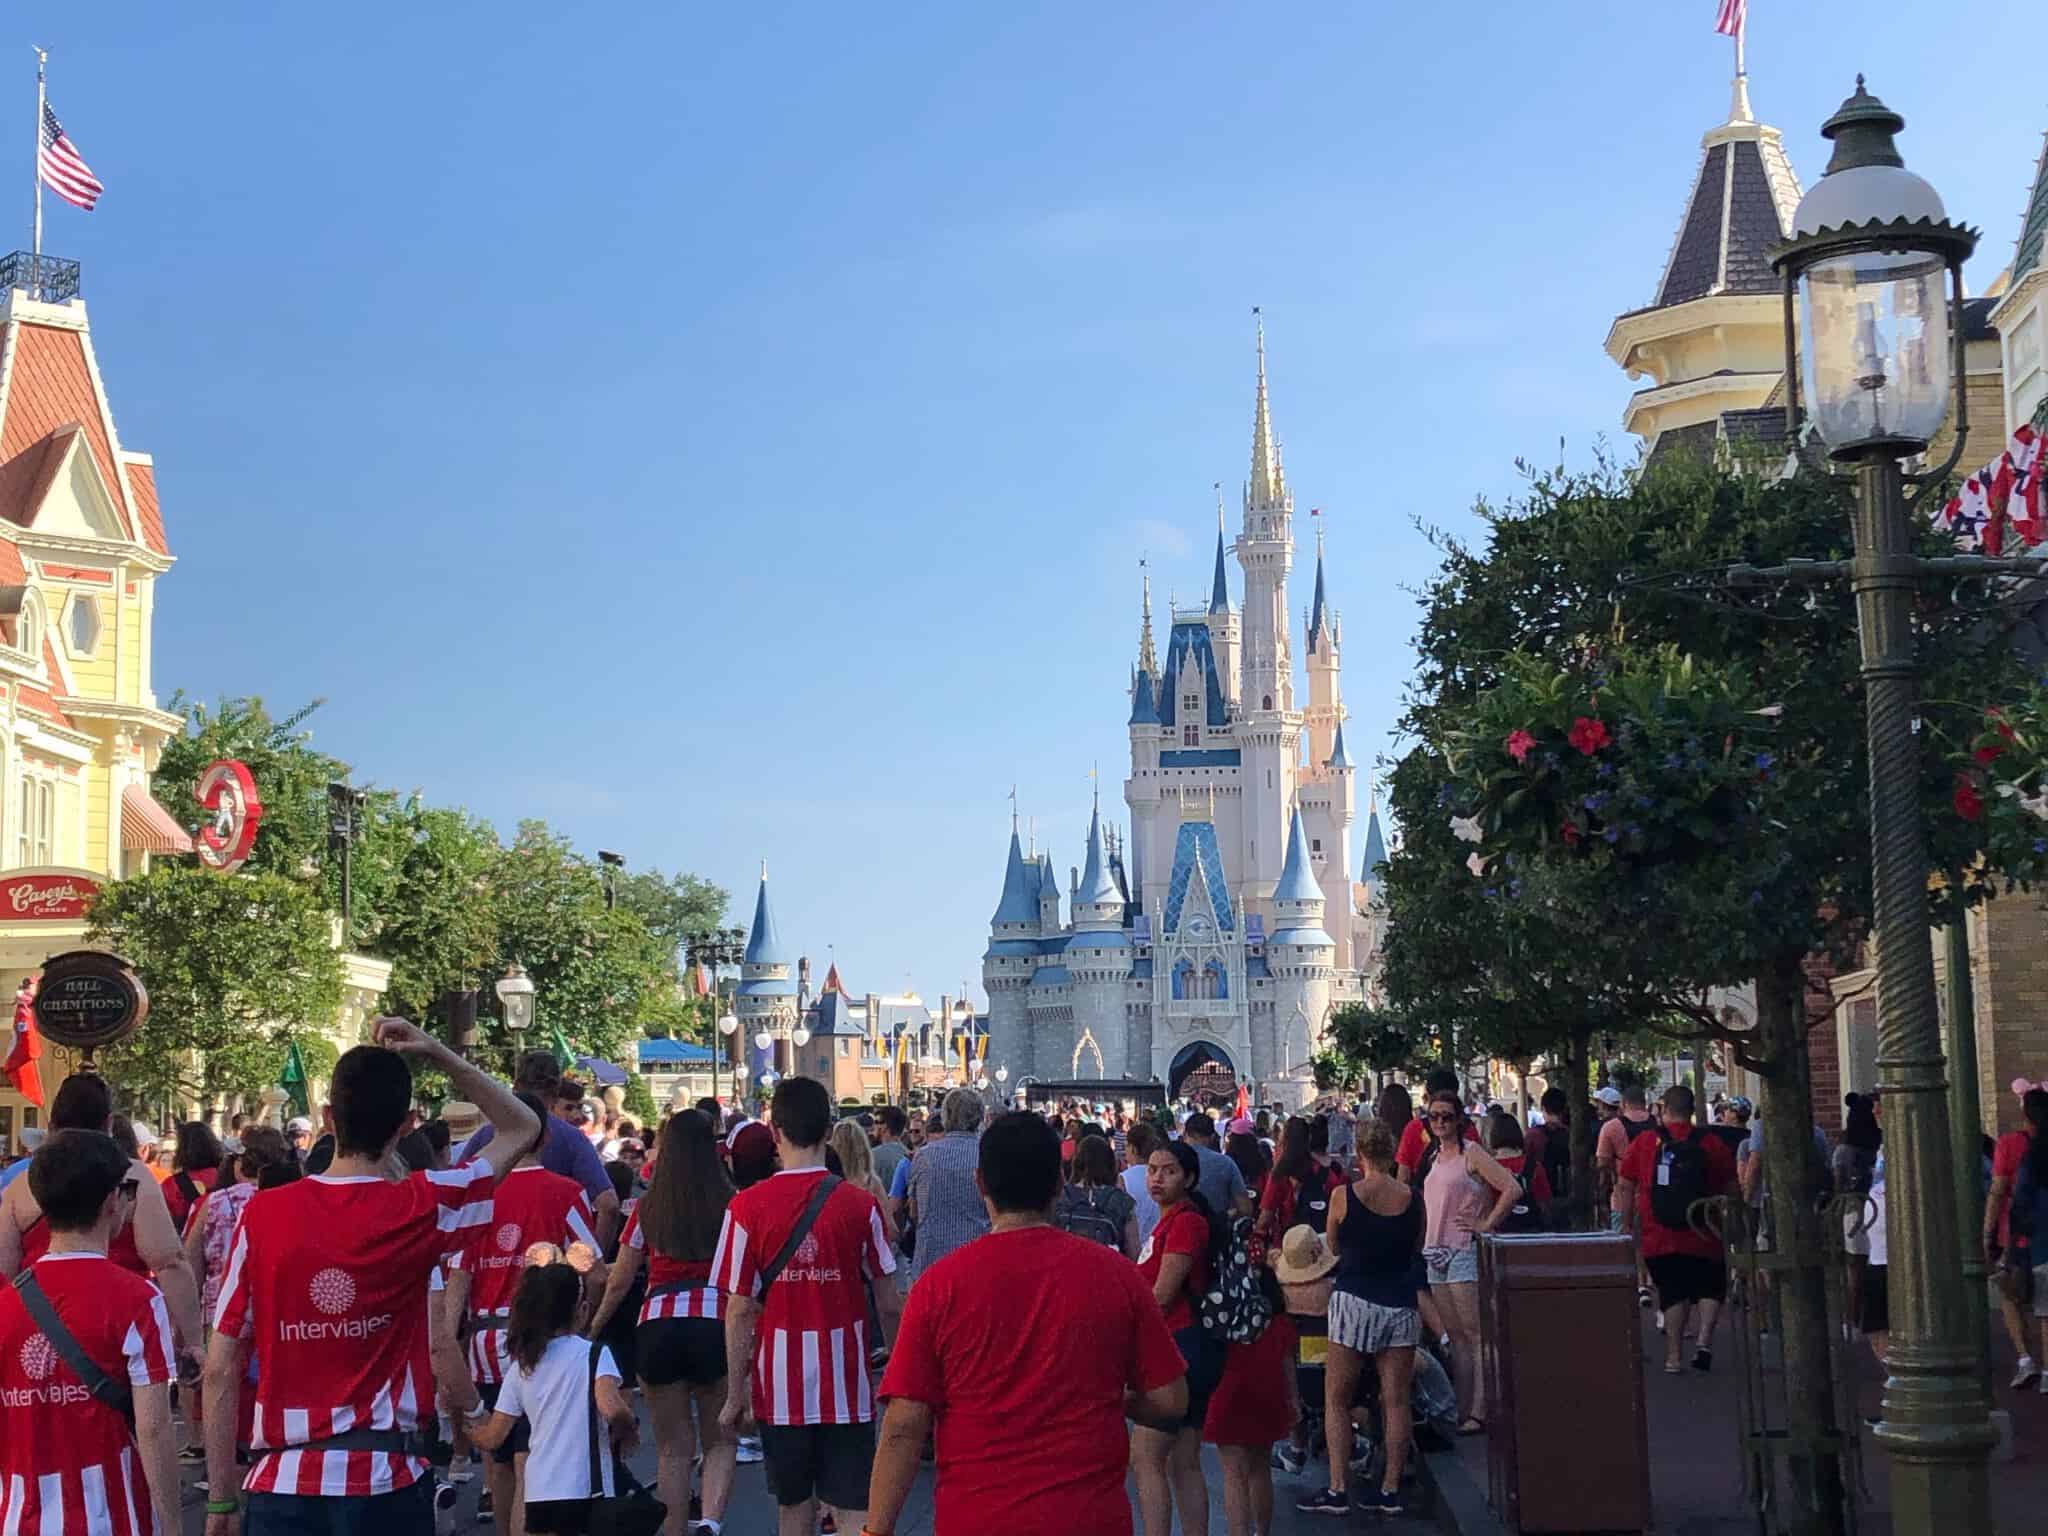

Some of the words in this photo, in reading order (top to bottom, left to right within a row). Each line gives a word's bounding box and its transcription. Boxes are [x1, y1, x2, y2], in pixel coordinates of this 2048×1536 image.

[8, 879, 79, 912] Casey's
[42, 999, 125, 1011] CHAMPIONS
[280, 1314, 392, 1341] Interviajes
